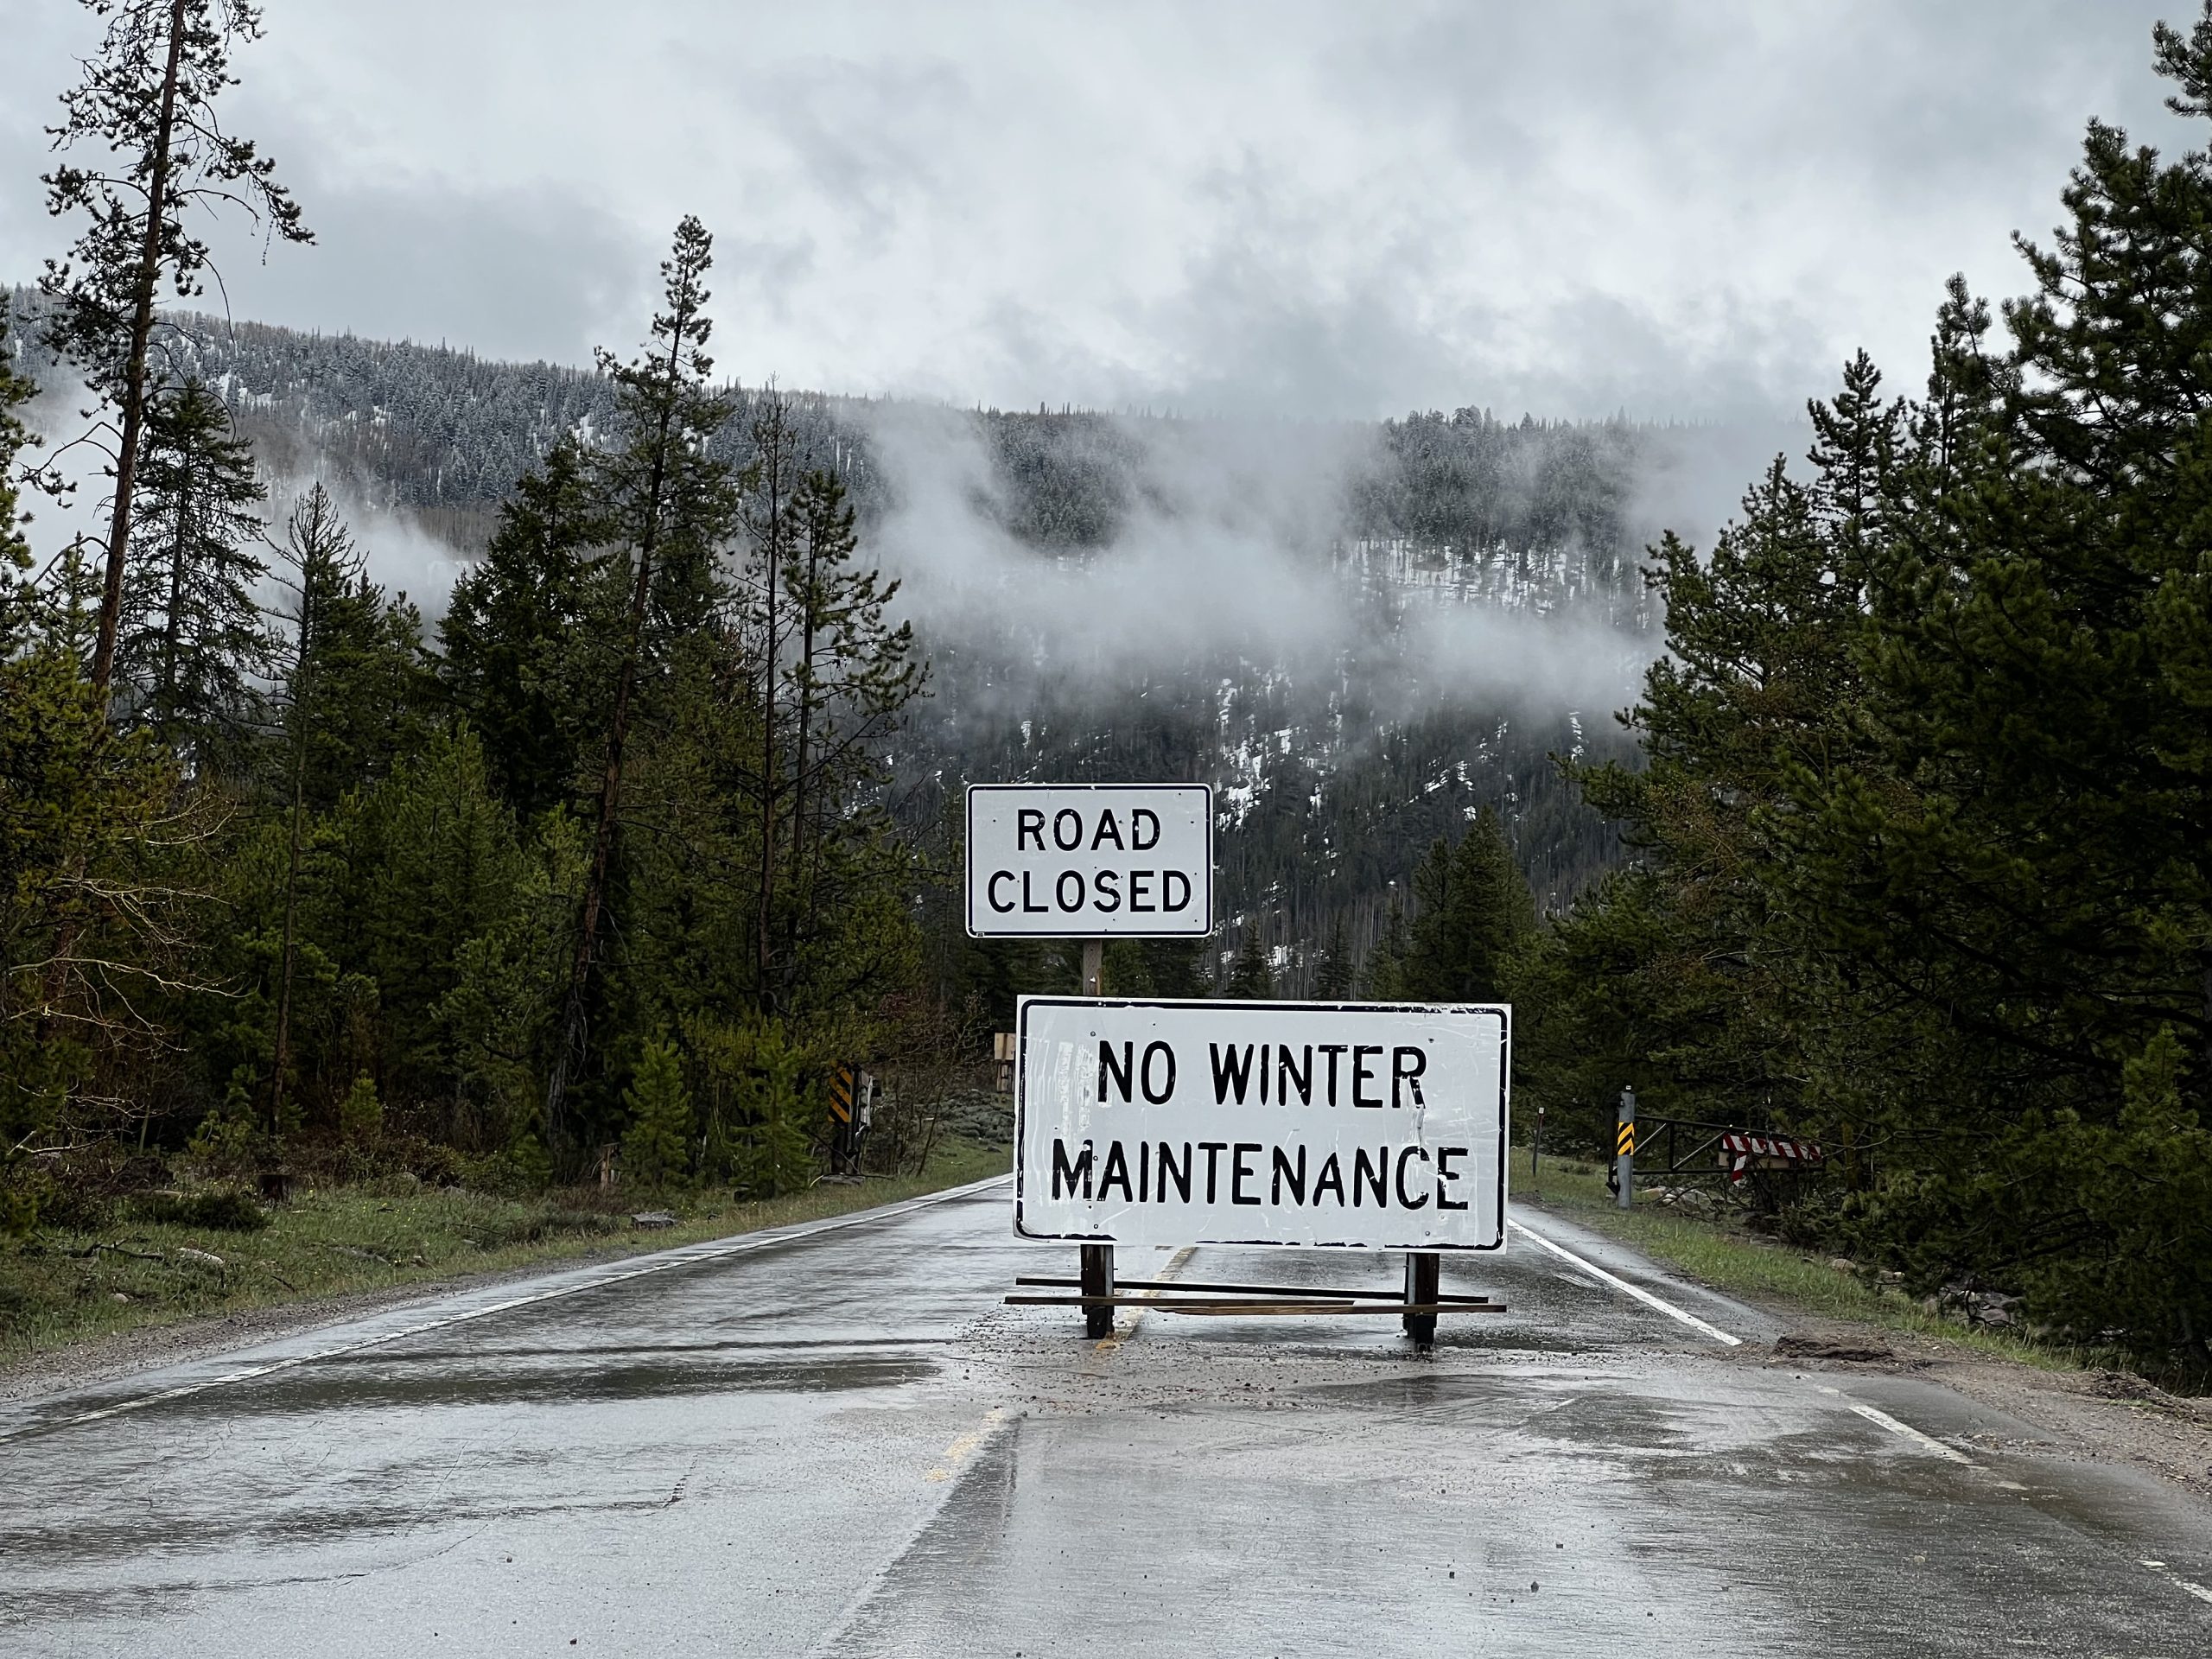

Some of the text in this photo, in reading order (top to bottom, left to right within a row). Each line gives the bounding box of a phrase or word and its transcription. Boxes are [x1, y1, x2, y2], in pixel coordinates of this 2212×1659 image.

[1017, 809, 1160, 851] ROAD
[988, 870, 1192, 913] CLOSED
[1097, 1040, 1427, 1109] NO WINTER
[1051, 1138, 1470, 1211] MAINTENANCE
